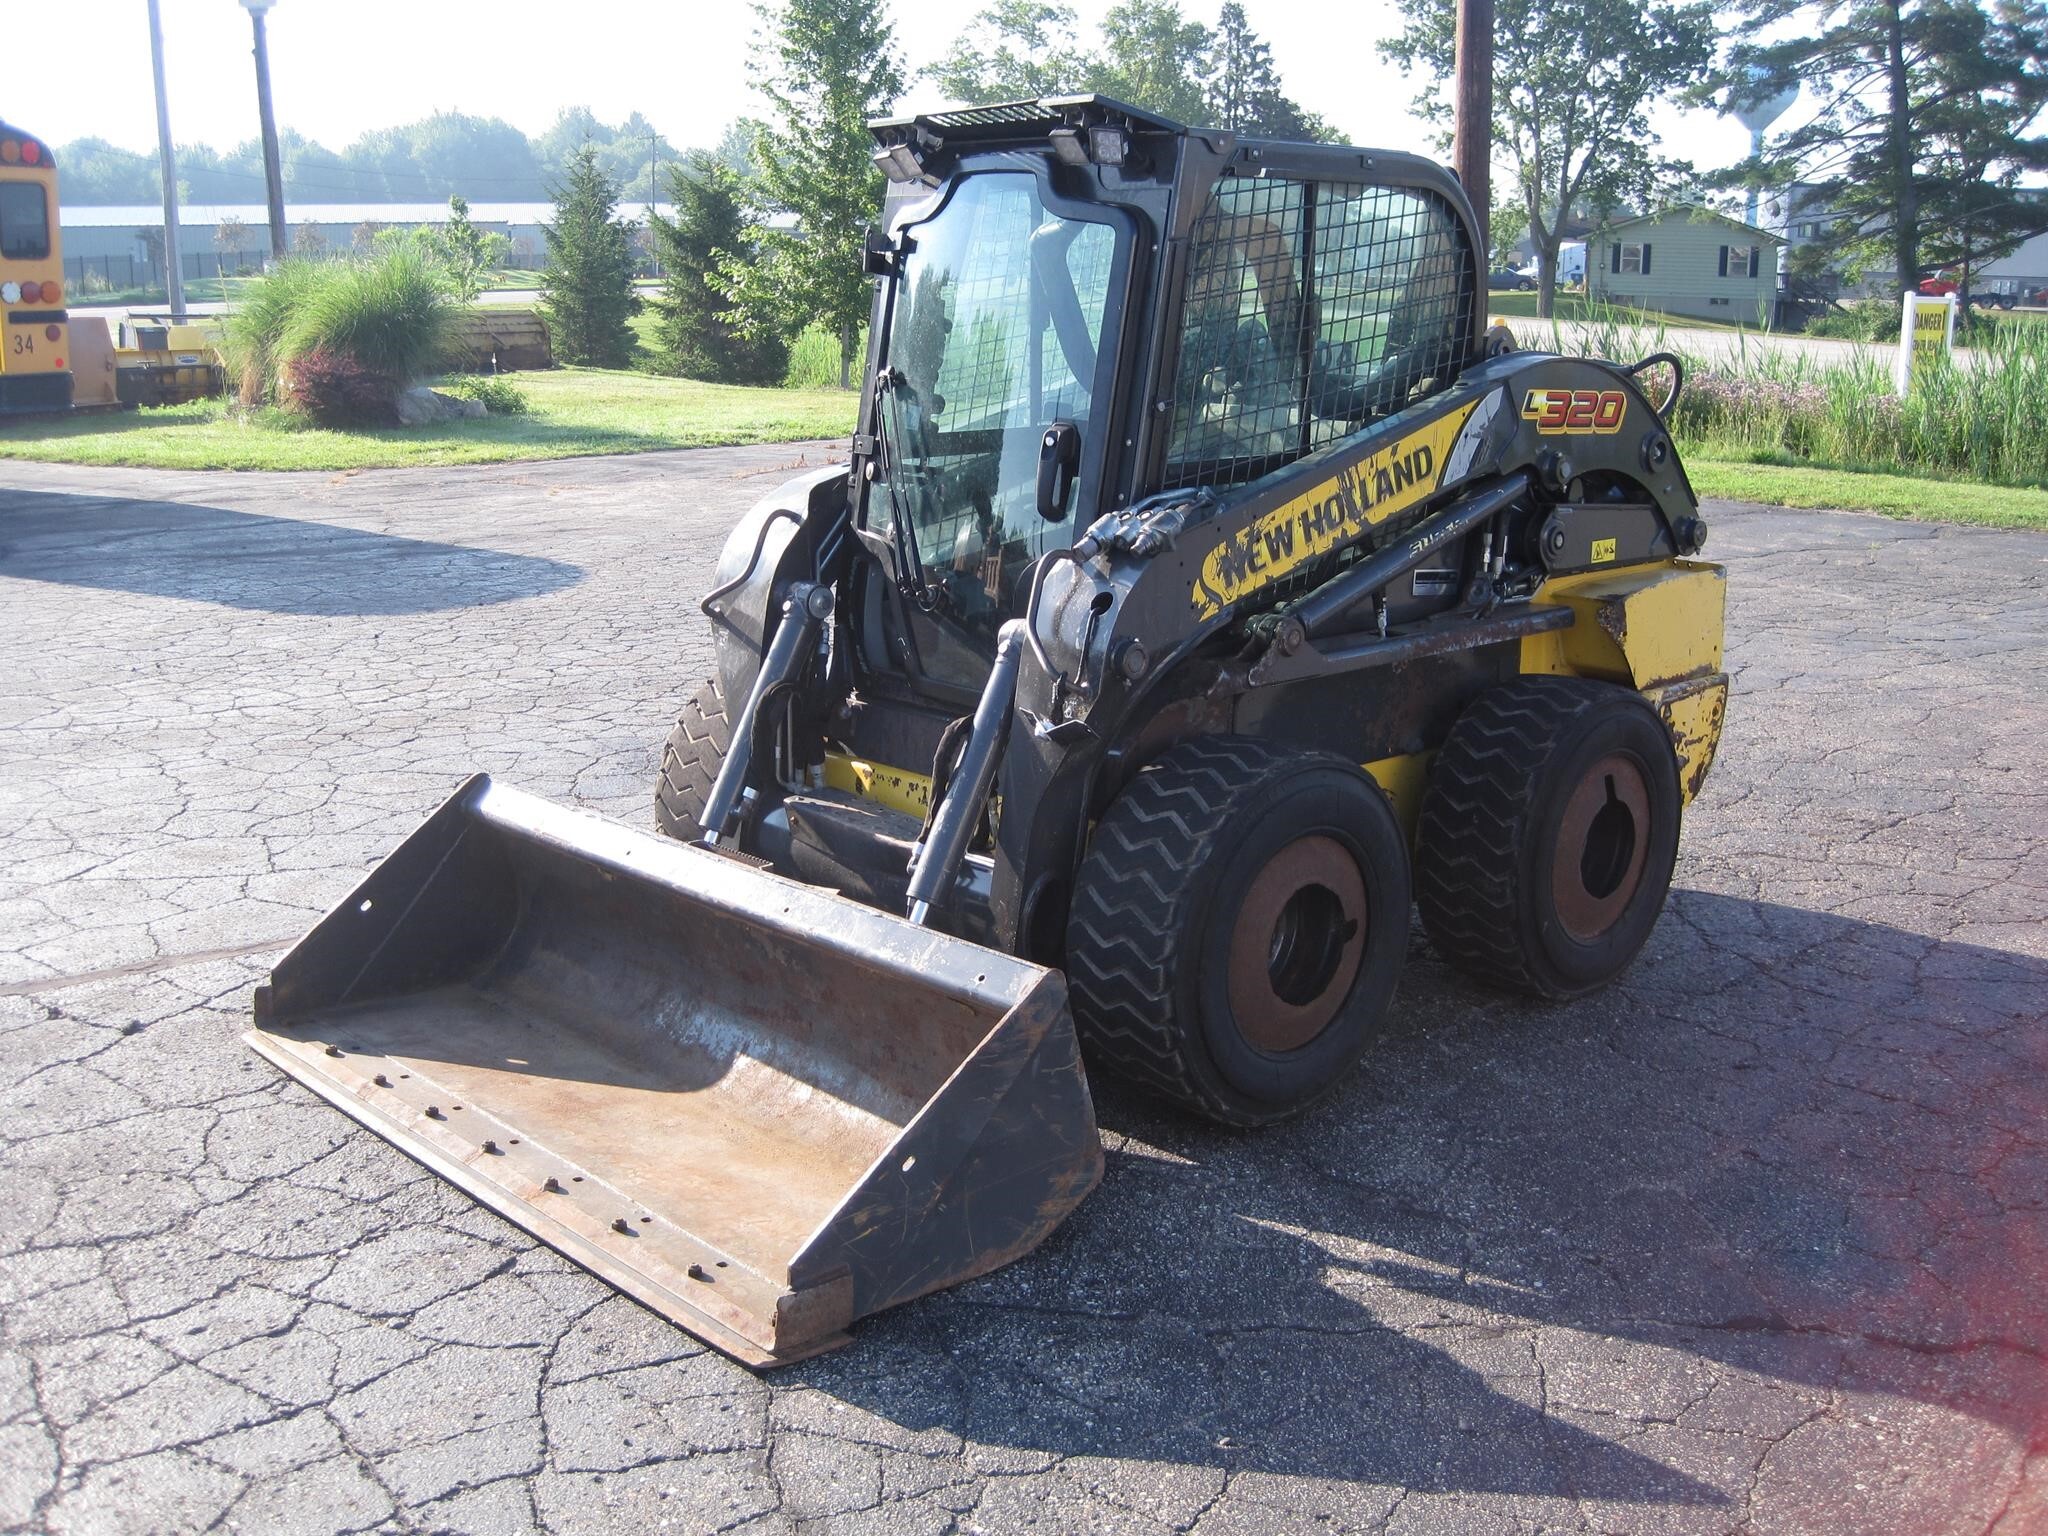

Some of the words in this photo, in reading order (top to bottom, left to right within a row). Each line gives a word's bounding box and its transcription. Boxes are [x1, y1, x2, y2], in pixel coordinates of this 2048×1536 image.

[14, 334, 33, 354] 34
[1218, 518, 1296, 589] NEW
[1301, 444, 1433, 545] HOLLAND
